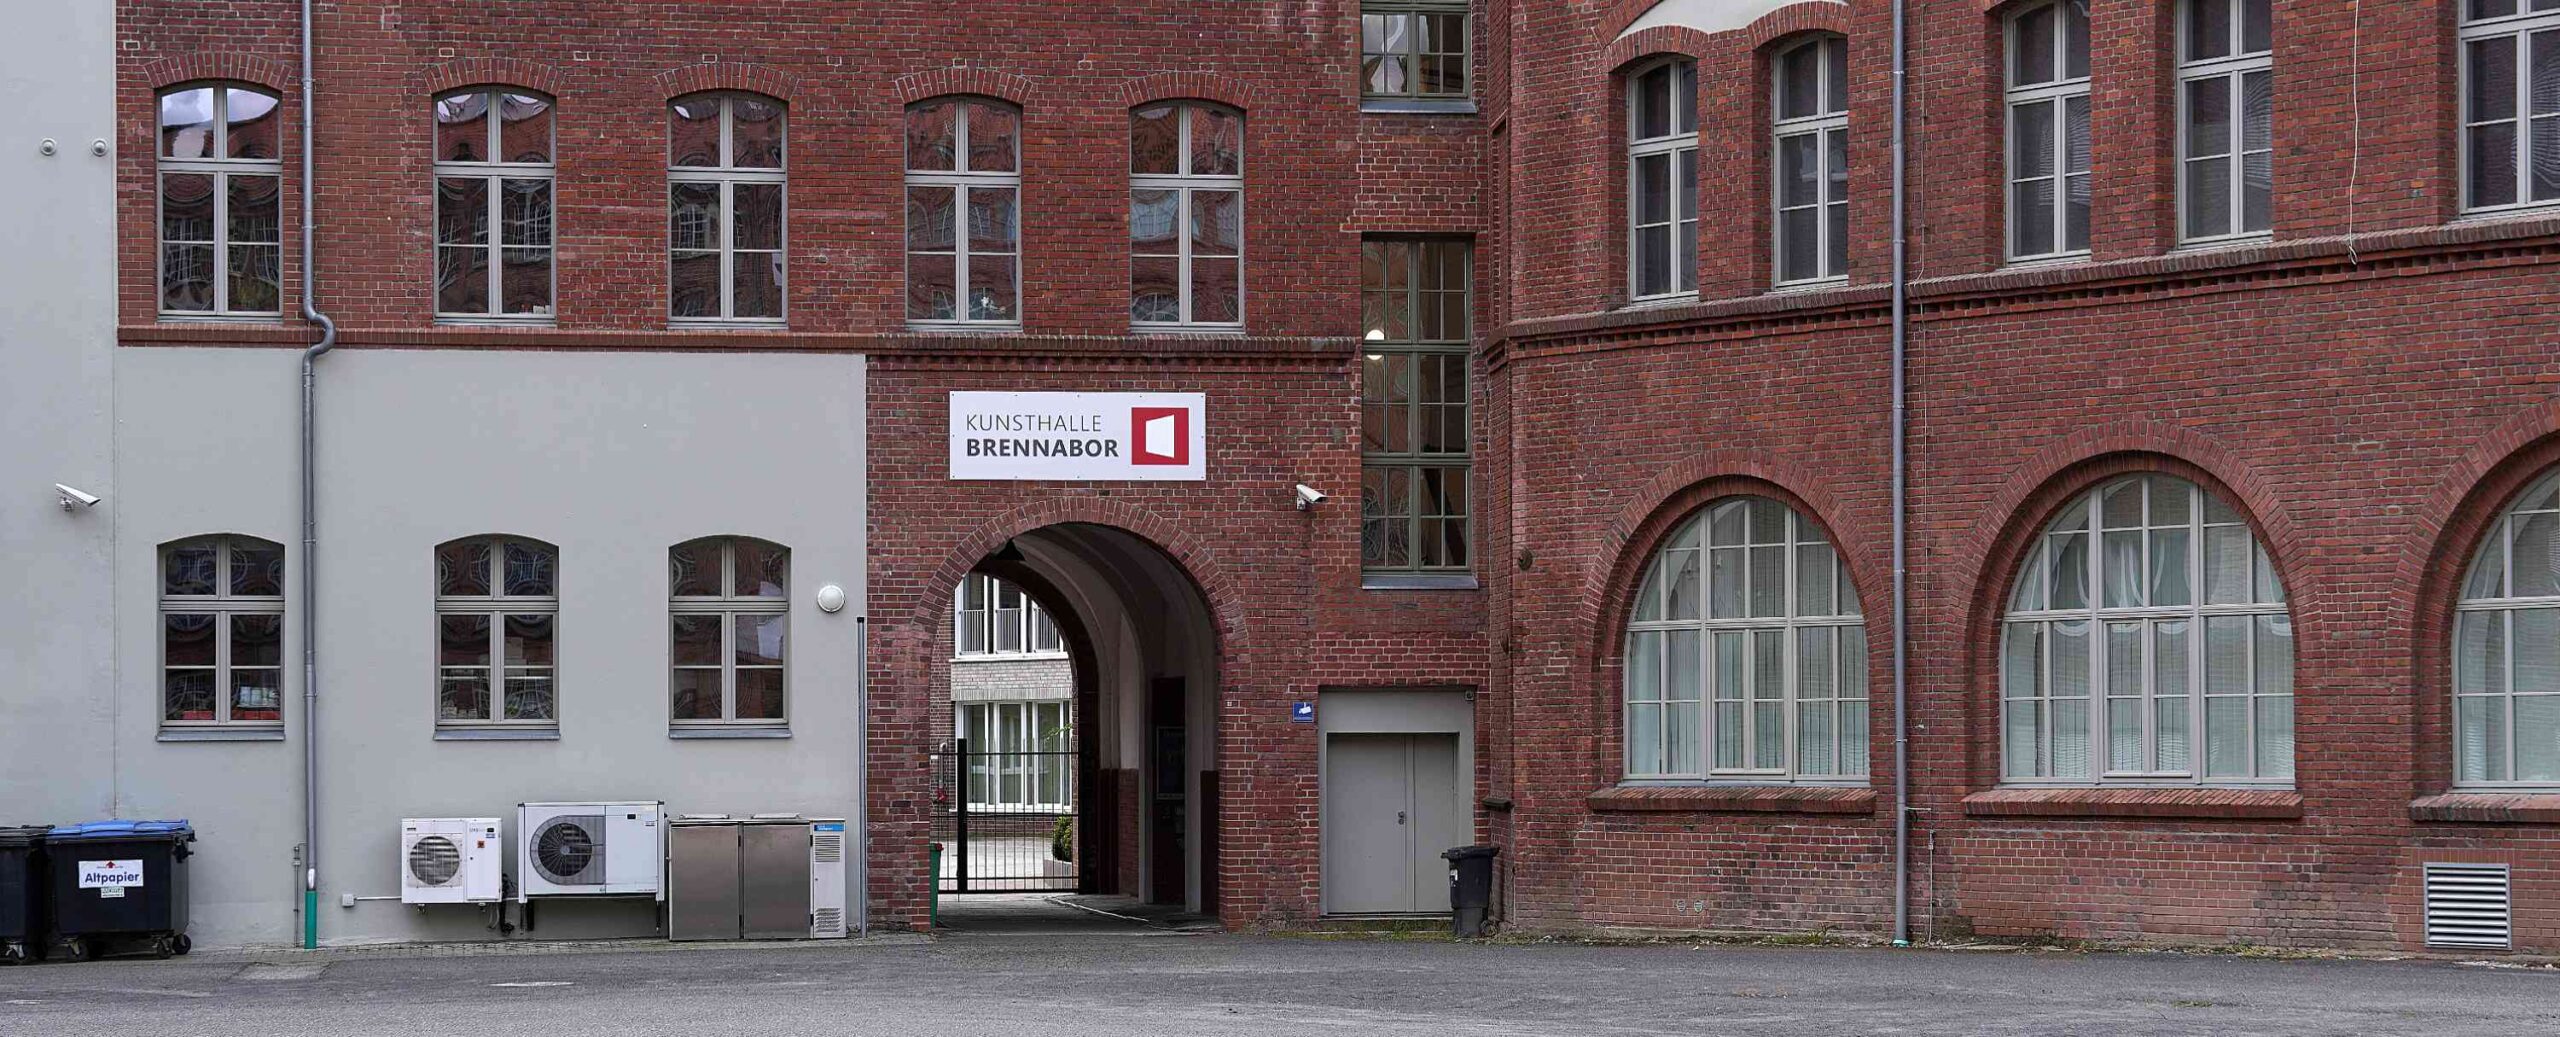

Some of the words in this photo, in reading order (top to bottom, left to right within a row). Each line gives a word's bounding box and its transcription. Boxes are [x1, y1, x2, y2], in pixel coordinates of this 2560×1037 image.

[966, 414, 1102, 432] KUNSTHALLE
[966, 438, 1119, 457] BRENNABOR
[85, 871, 140, 885] Altpapier
